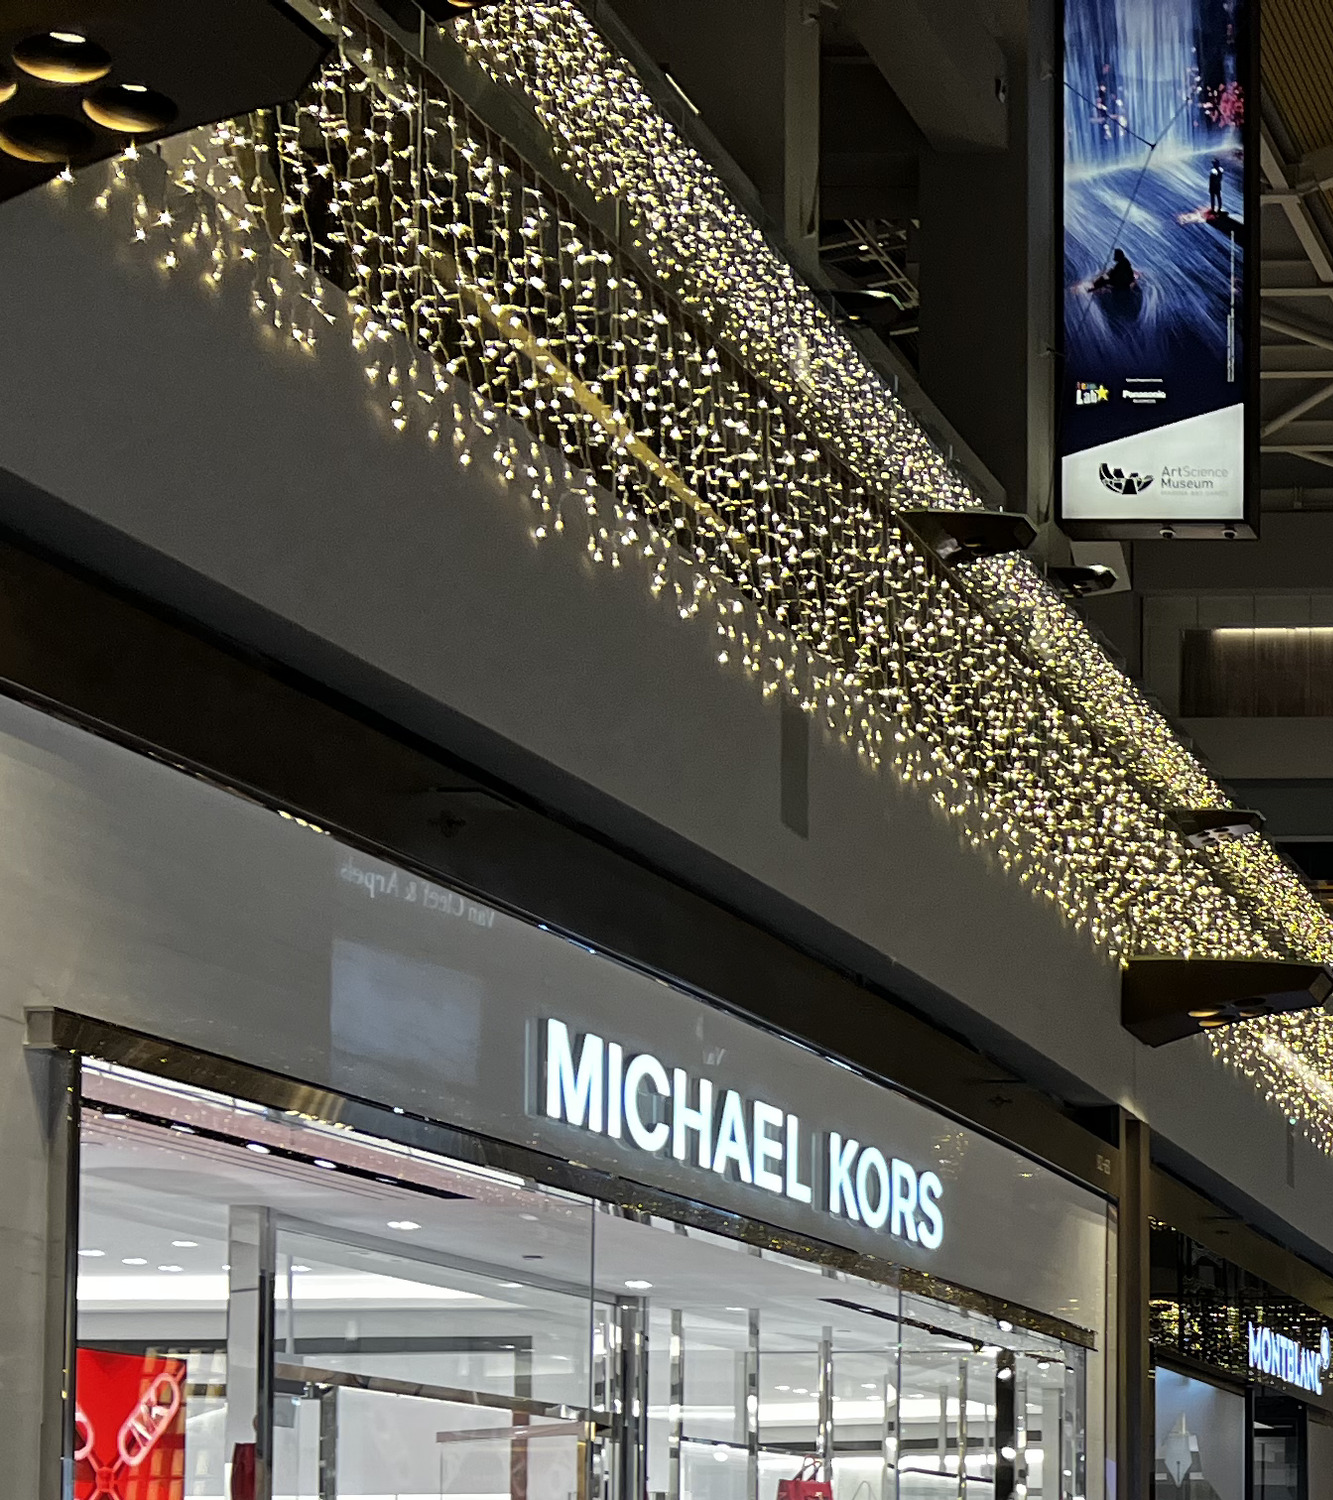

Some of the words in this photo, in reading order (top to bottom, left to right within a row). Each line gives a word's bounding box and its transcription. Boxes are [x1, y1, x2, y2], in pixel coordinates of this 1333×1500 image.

[1161, 466, 1229, 478] ArtScience
[1161, 479, 1214, 489] Museum
[545, 1017, 812, 1204] MICHAEL
[829, 1131, 944, 1250] KORS
[1248, 1320, 1323, 1396] MONTBLANC
